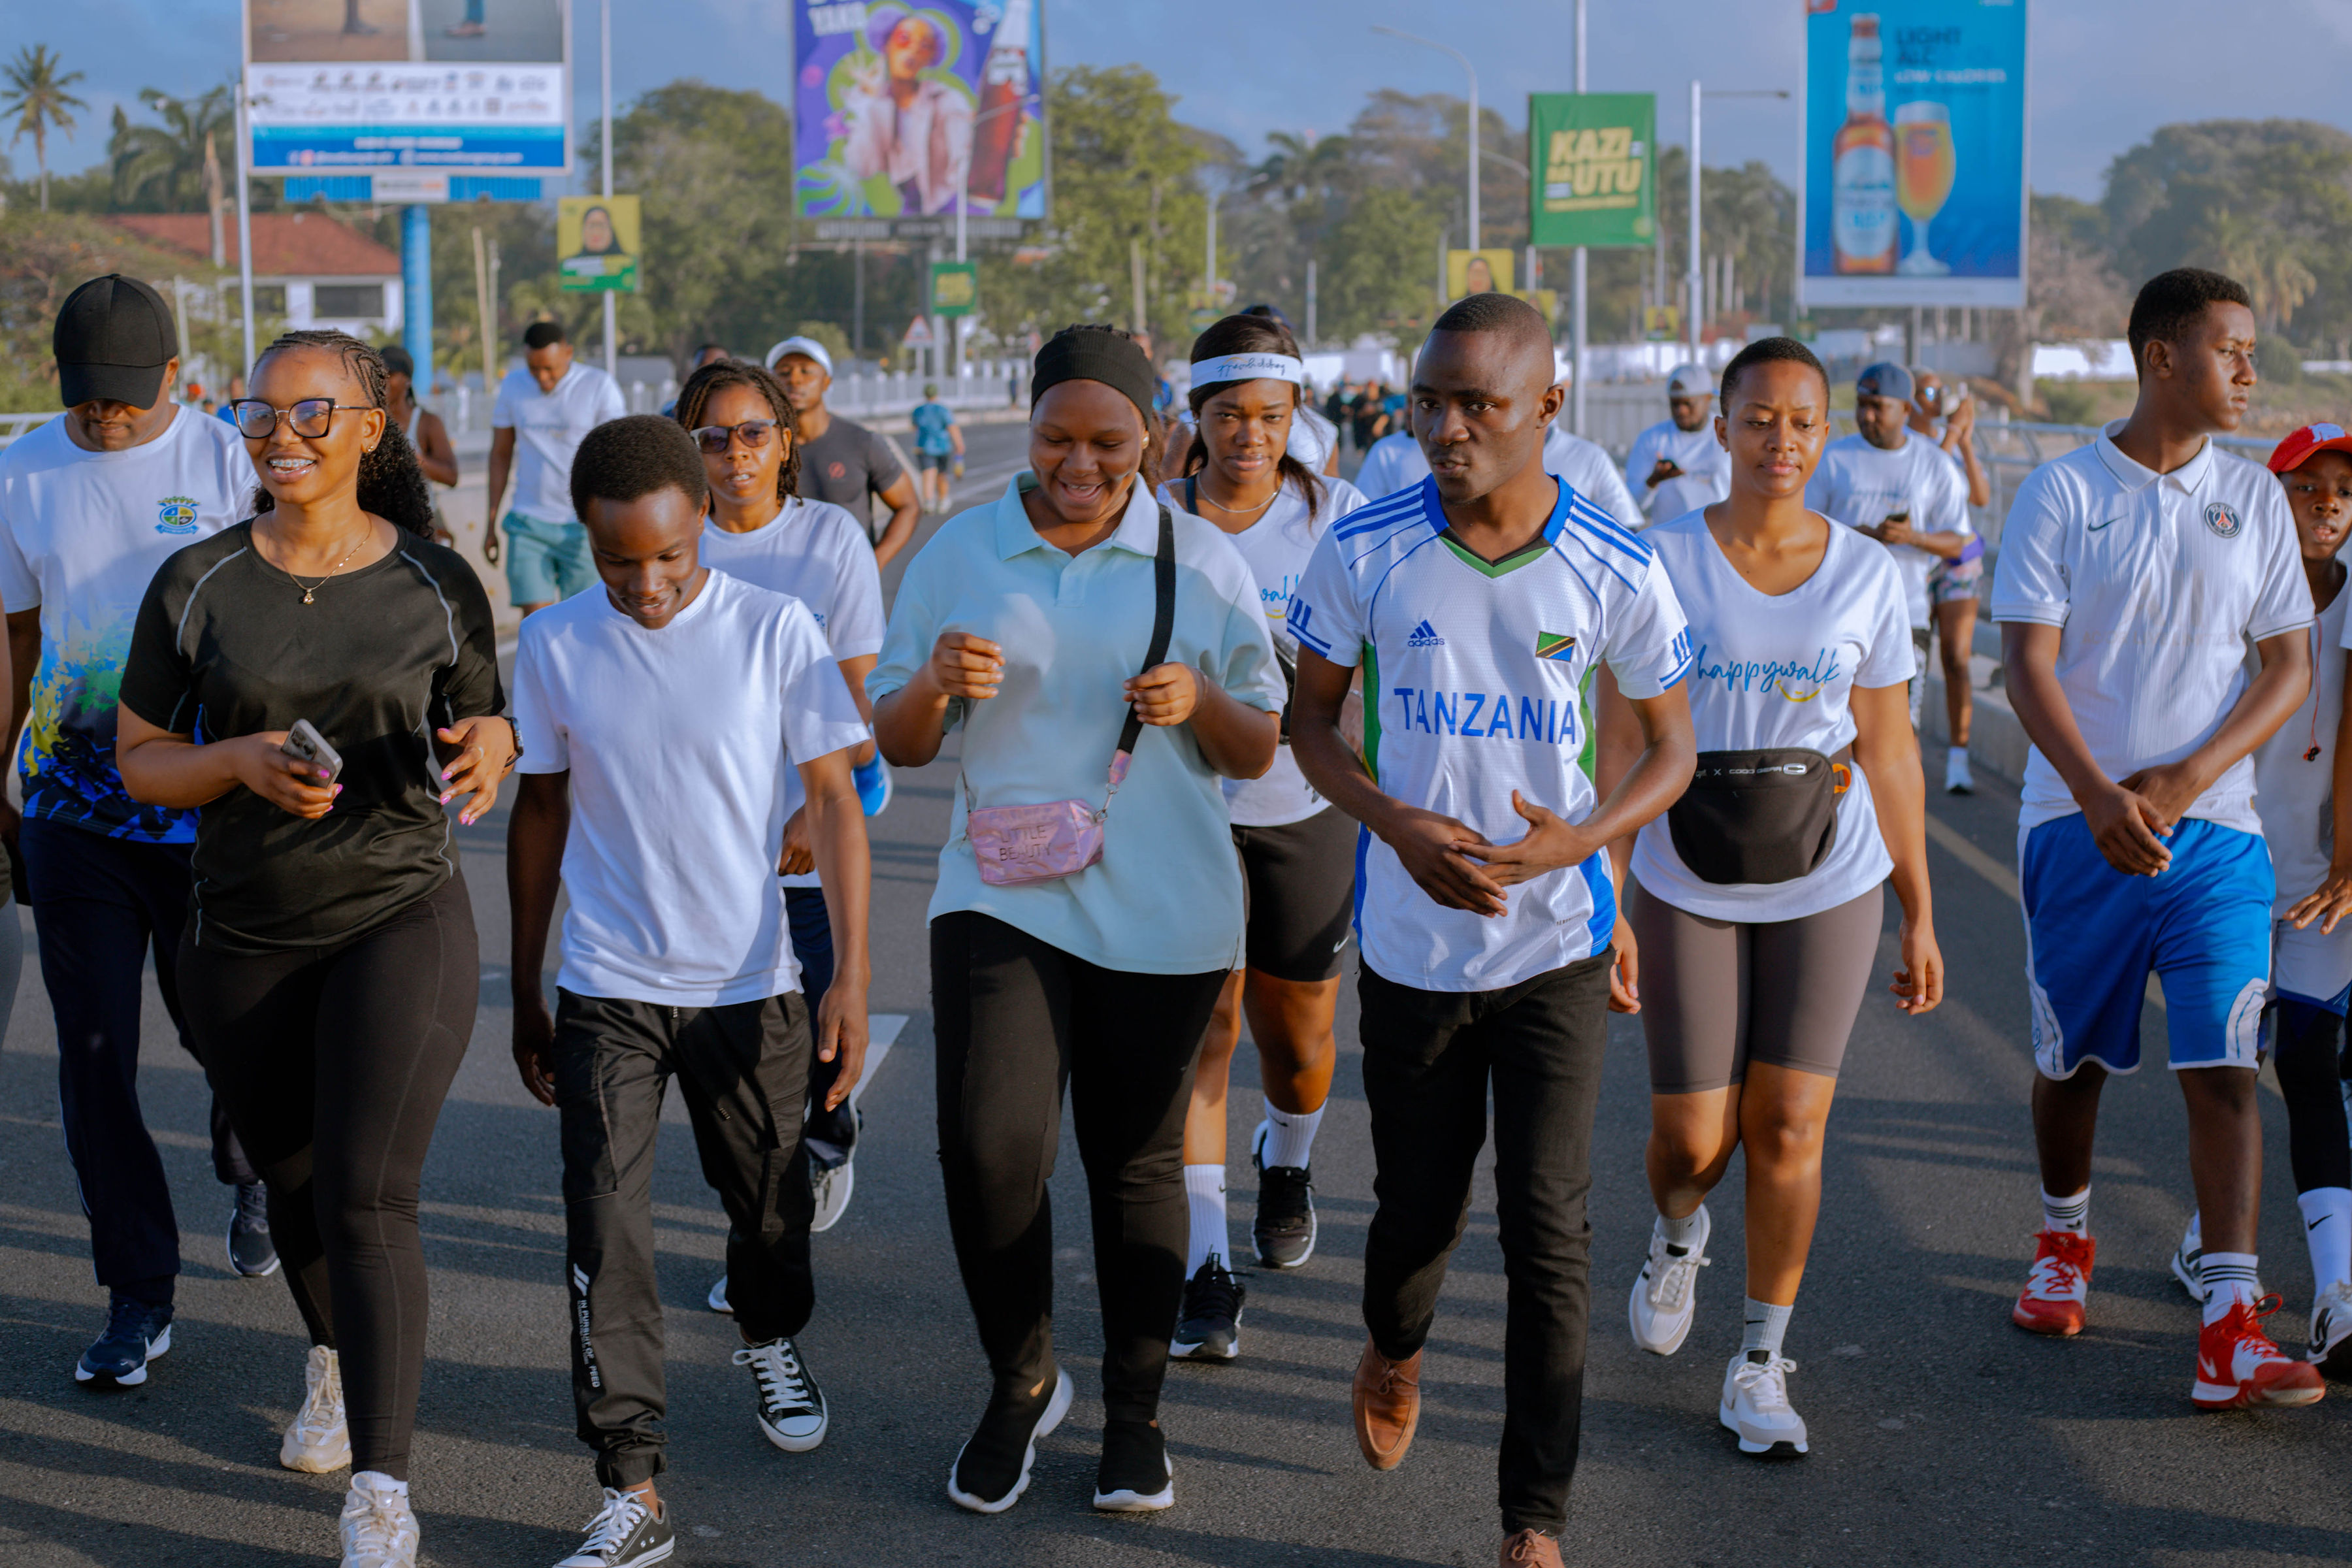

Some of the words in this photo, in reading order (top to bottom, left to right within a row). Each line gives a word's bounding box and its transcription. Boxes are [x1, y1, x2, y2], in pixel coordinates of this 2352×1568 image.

[1549, 127, 1633, 163] KAZI
[1573, 159, 1642, 196] UTU
[1408, 638, 1445, 647] adidas
[1697, 644, 1840, 693] happywalk
[1394, 688, 1576, 745] TANZANIA
[1000, 843, 1051, 862] BEAUTY
[589, 1365, 600, 1388] PEED
